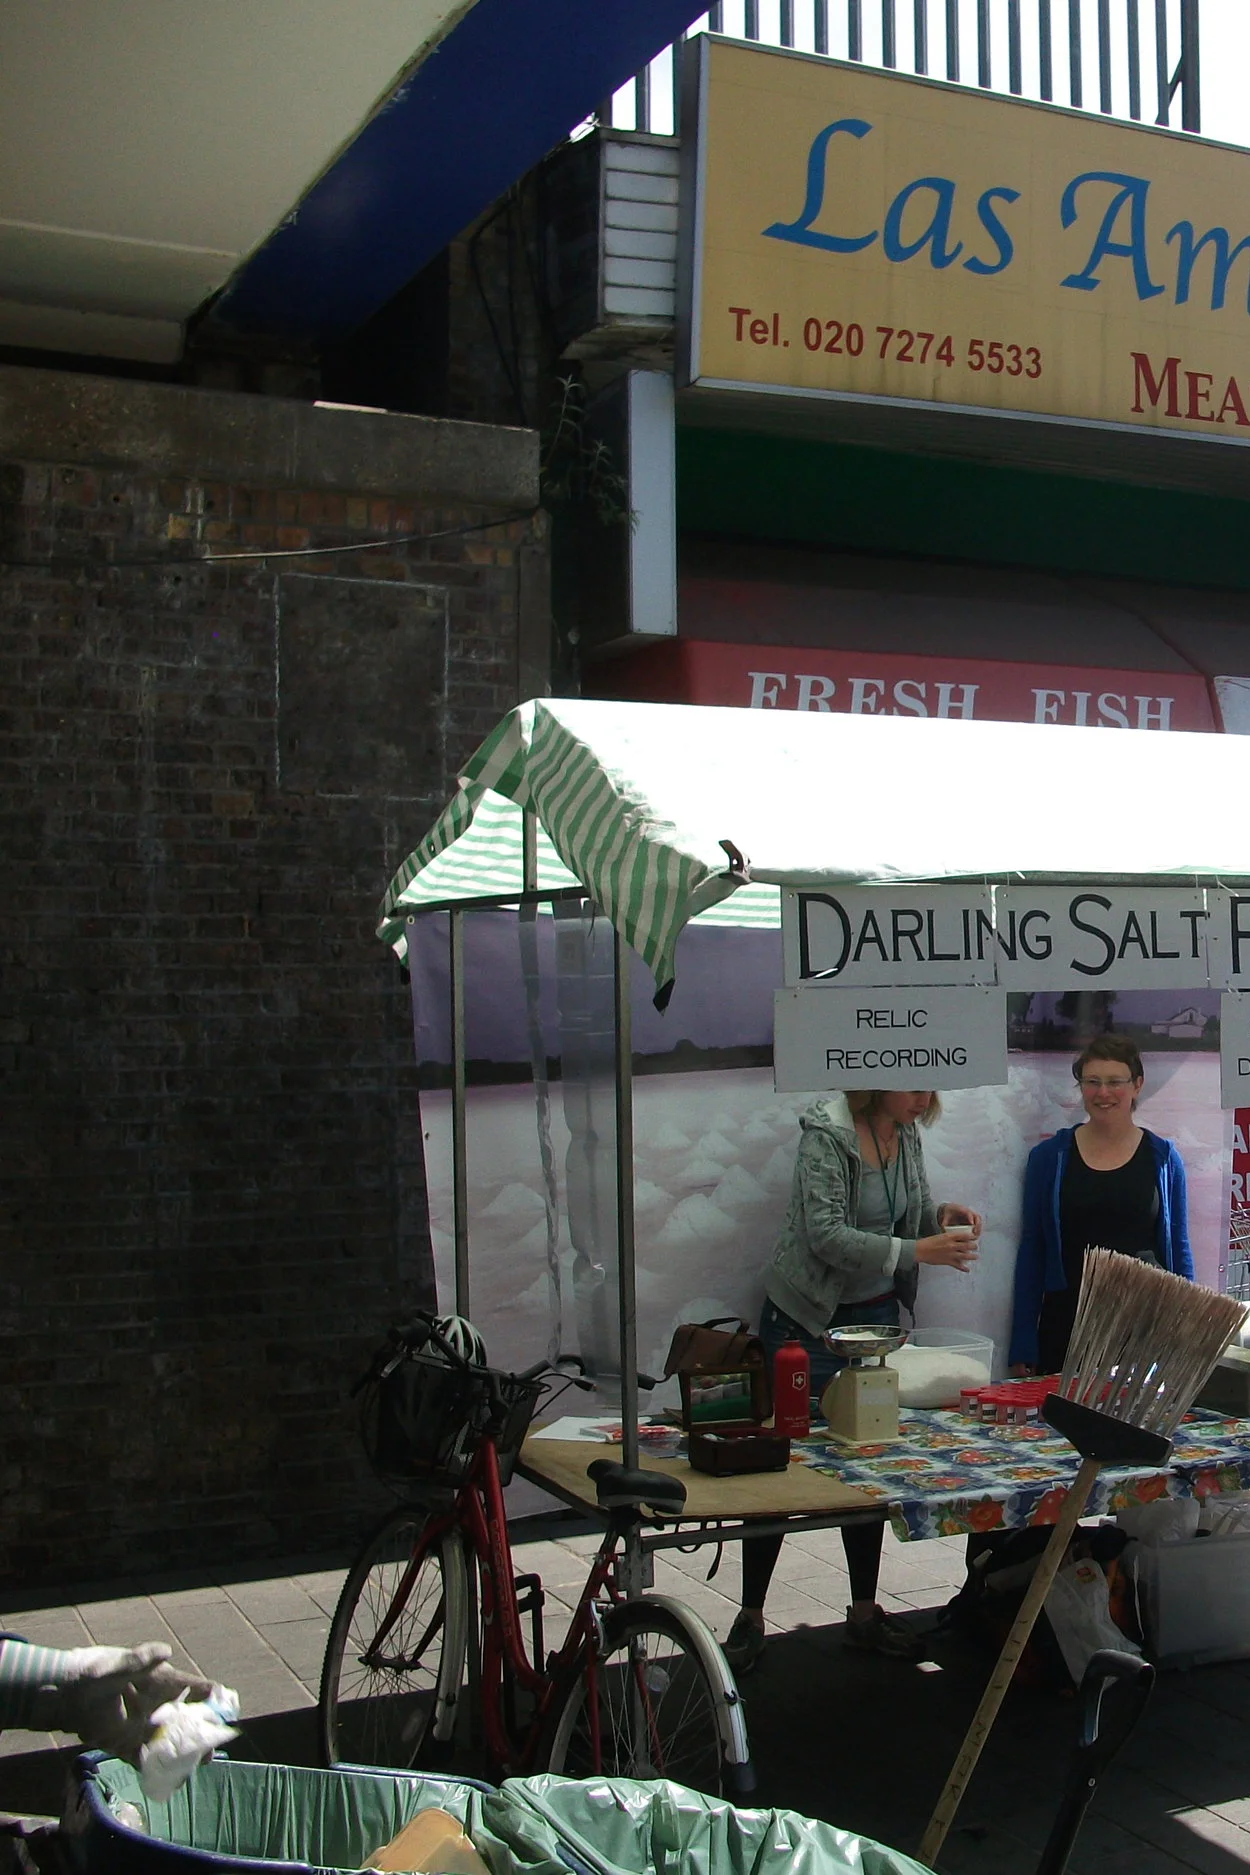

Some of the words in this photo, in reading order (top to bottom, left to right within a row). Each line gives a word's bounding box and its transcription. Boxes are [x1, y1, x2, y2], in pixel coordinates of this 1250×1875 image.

[762, 118, 1021, 275] Las
[729, 307, 789, 347] Tel.
[804, 317, 864, 356] 020
[876, 326, 955, 367] 7274
[968, 338, 1042, 378] 5533
[748, 672, 979, 720] FRESH
[1032, 689, 1175, 731] FISH
[797, 892, 1053, 980] DARLING
[1069, 893, 1211, 976] SALT
[856, 1008, 928, 1028] RELIC
[826, 1047, 967, 1070] RECORDING
